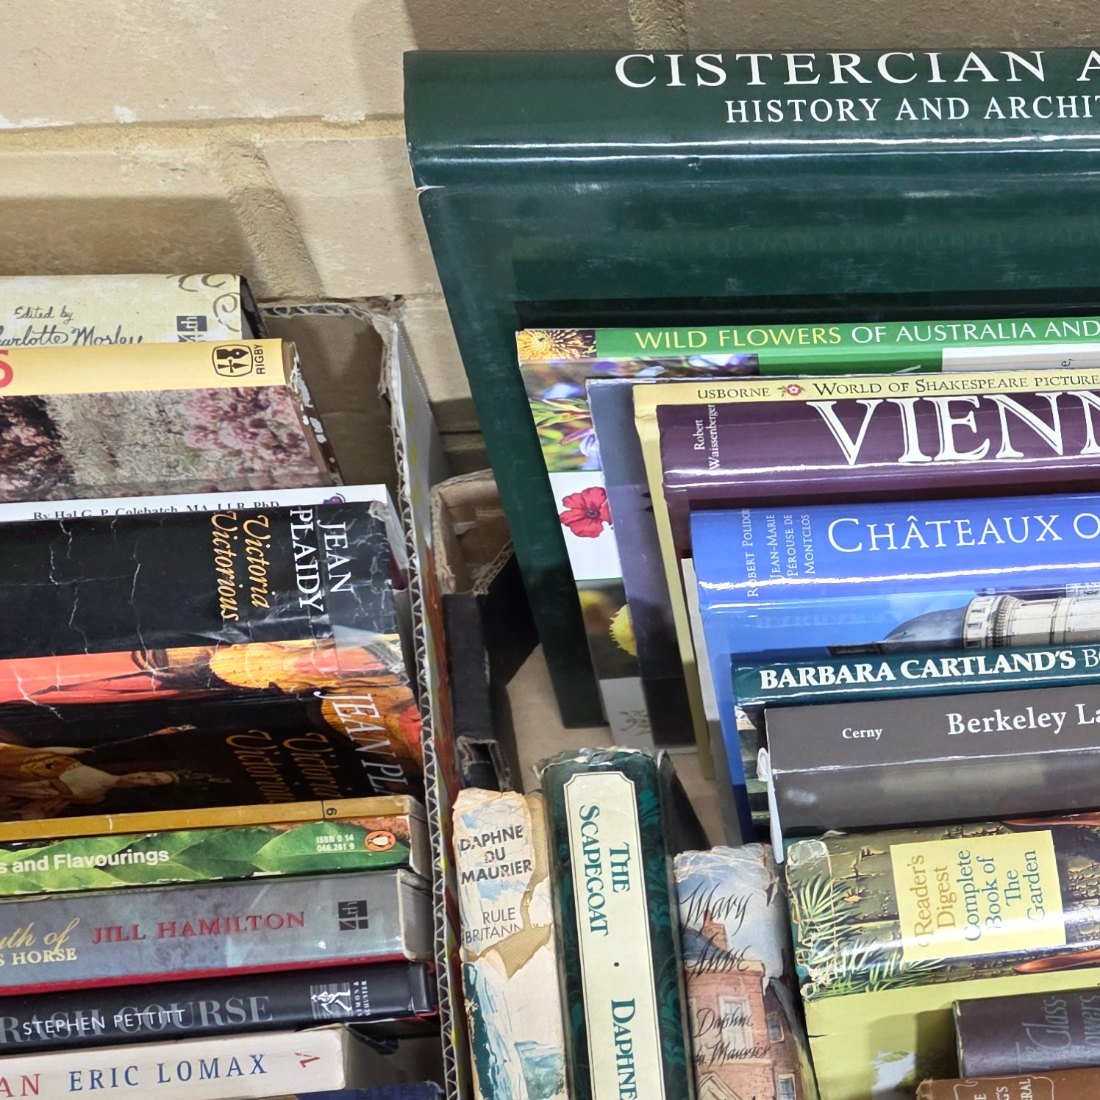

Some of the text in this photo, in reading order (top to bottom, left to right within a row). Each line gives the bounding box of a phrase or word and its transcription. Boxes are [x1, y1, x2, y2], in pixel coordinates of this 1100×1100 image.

[614, 50, 1046, 89] CISTERCIAN
[725, 96, 881, 123] HISTORY
[895, 94, 971, 121] AND
[635, 328, 707, 350] WILD
[719, 325, 842, 347] FLOWERS
[851, 324, 887, 344] OF
[896, 321, 1036, 342] AUSTRALIA
[1047, 318, 1100, 339] AND
[255, 344, 266, 375] RIGBY
[827, 508, 1062, 552] CHÂTEAUX
[211, 511, 276, 621] Victoria Victorious
[290, 508, 353, 612] JEAN PLAIDY
[760, 662, 896, 690] BARBARA
[900, 650, 1076, 679] CARTLAND'S
[842, 726, 883, 741] Cerny
[948, 706, 1068, 737] Berkeley
[460, 825, 525, 853] DAPHNE
[485, 850, 506, 864] DU
[13, 847, 169, 871] and Flavourings
[461, 859, 533, 885] MAURIER
[579, 805, 608, 936] SCAPEGOAT
[610, 842, 630, 893] THE
[907, 854, 957, 947] Reader's Digest
[956, 849, 982, 941] Complete
[977, 856, 1002, 928] Book of
[1004, 869, 1021, 906] The
[1023, 850, 1045, 921] Garden
[92, 911, 305, 944] JILL HAMILTON
[12, 948, 77, 965] HORSE
[23, 1009, 185, 1036] STEPHEN PETTITT
[68, 1054, 268, 1093] ERIC LOMAX
